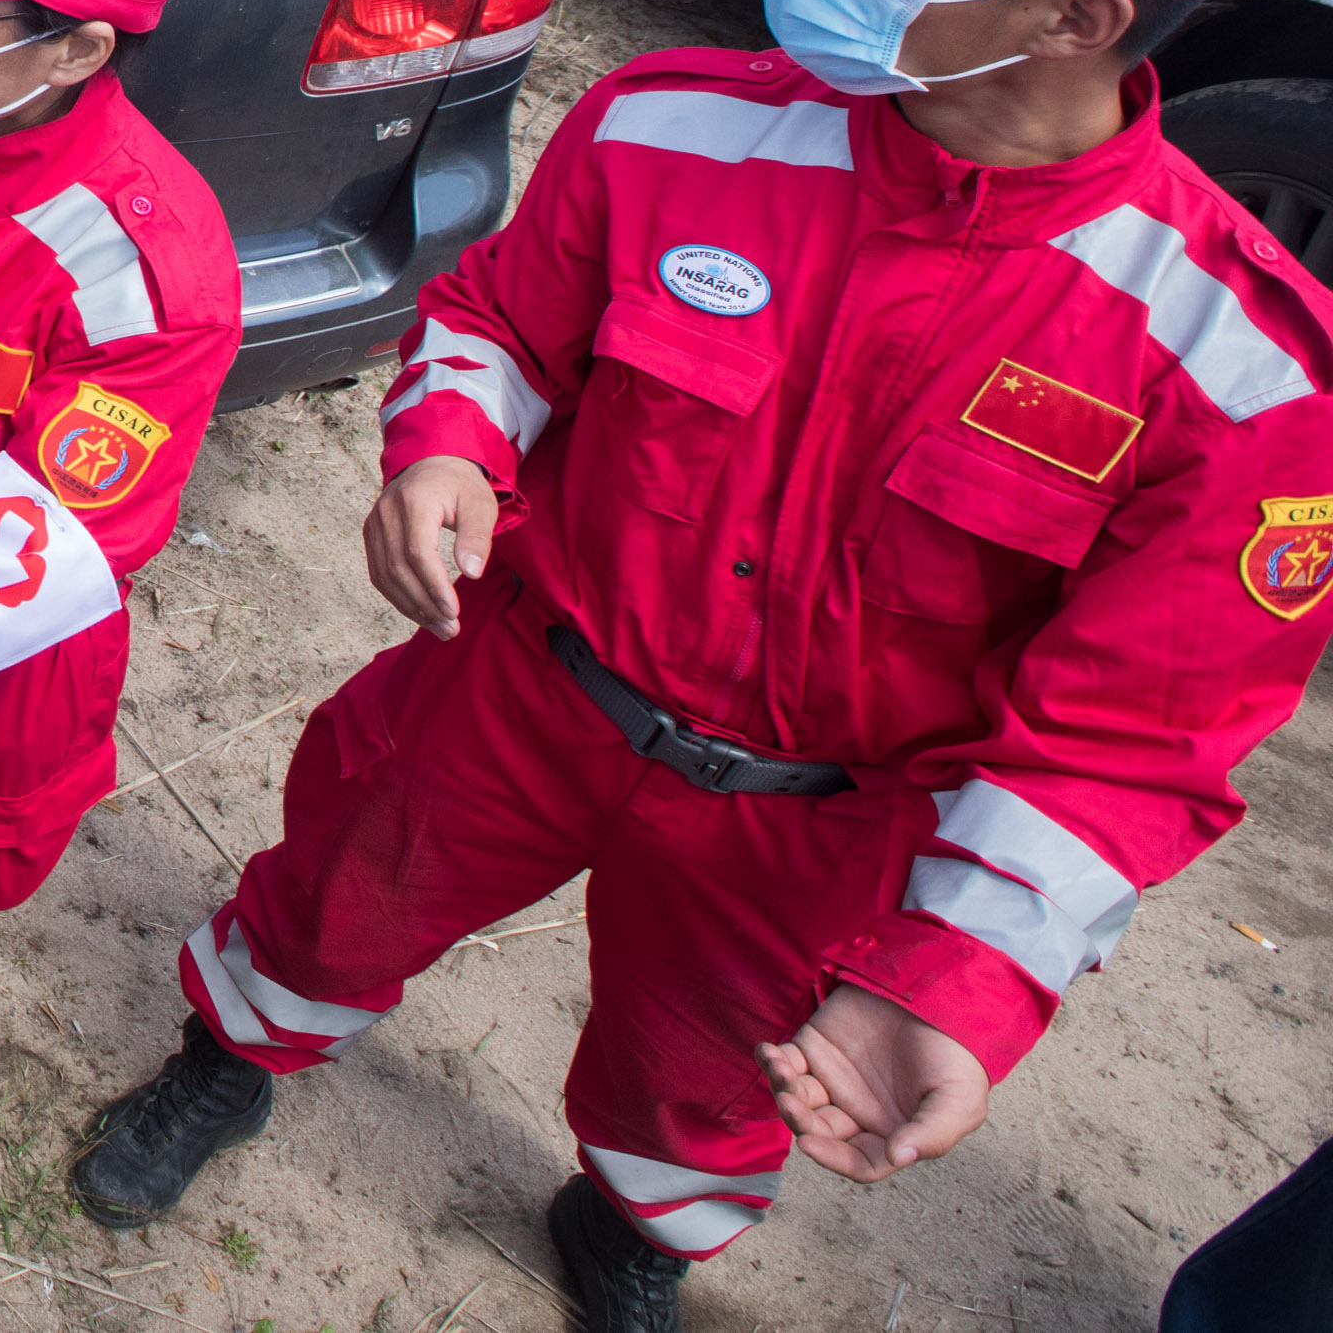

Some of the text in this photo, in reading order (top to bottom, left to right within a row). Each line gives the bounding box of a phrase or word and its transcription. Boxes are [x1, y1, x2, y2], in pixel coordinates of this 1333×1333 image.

[375, 117, 413, 141] V6
[676, 251, 763, 287] UNITED NATIONS
[676, 266, 750, 299] INSARAG
[668, 278, 689, 295] HEAVY
[687, 293, 707, 305] USAR
[708, 301, 727, 310] Team
[685, 283, 731, 303] Classified
[92, 399, 153, 440] CISAR
[1288, 504, 1333, 523] CIS
